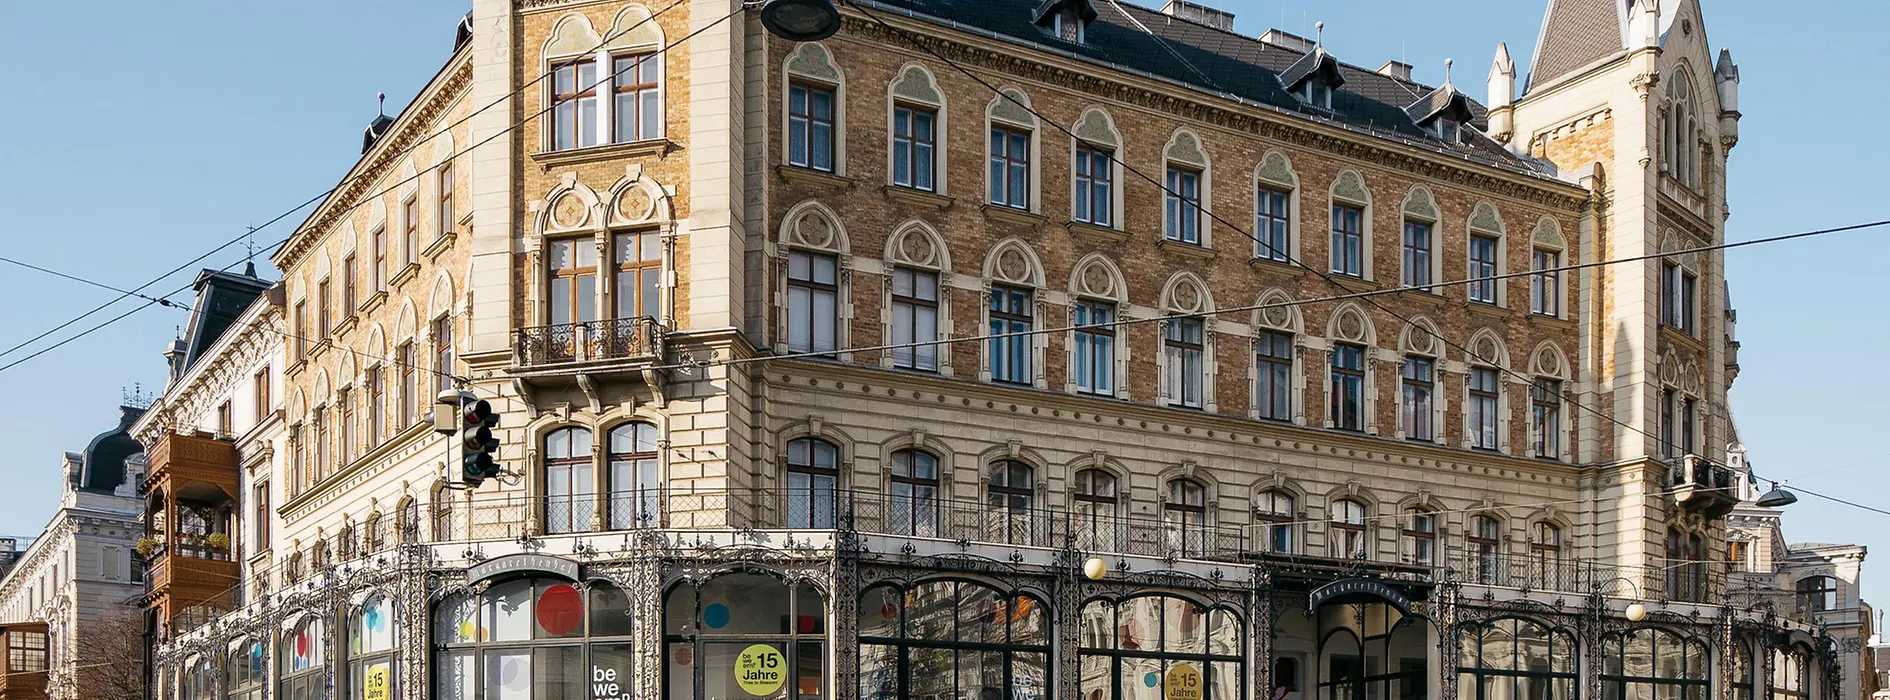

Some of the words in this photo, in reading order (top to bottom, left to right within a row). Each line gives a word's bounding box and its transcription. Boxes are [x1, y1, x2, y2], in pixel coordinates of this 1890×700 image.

[757, 653, 778, 668] 15
[374, 672, 383, 687] 15
[593, 665, 616, 681] be
[743, 670, 778, 680] Jahre
[1012, 674, 1032, 686] be
[1181, 673, 1196, 687] 15
[368, 689, 383, 699] Jahre
[593, 683, 619, 696] we
[1171, 687, 1197, 697] Jahre
